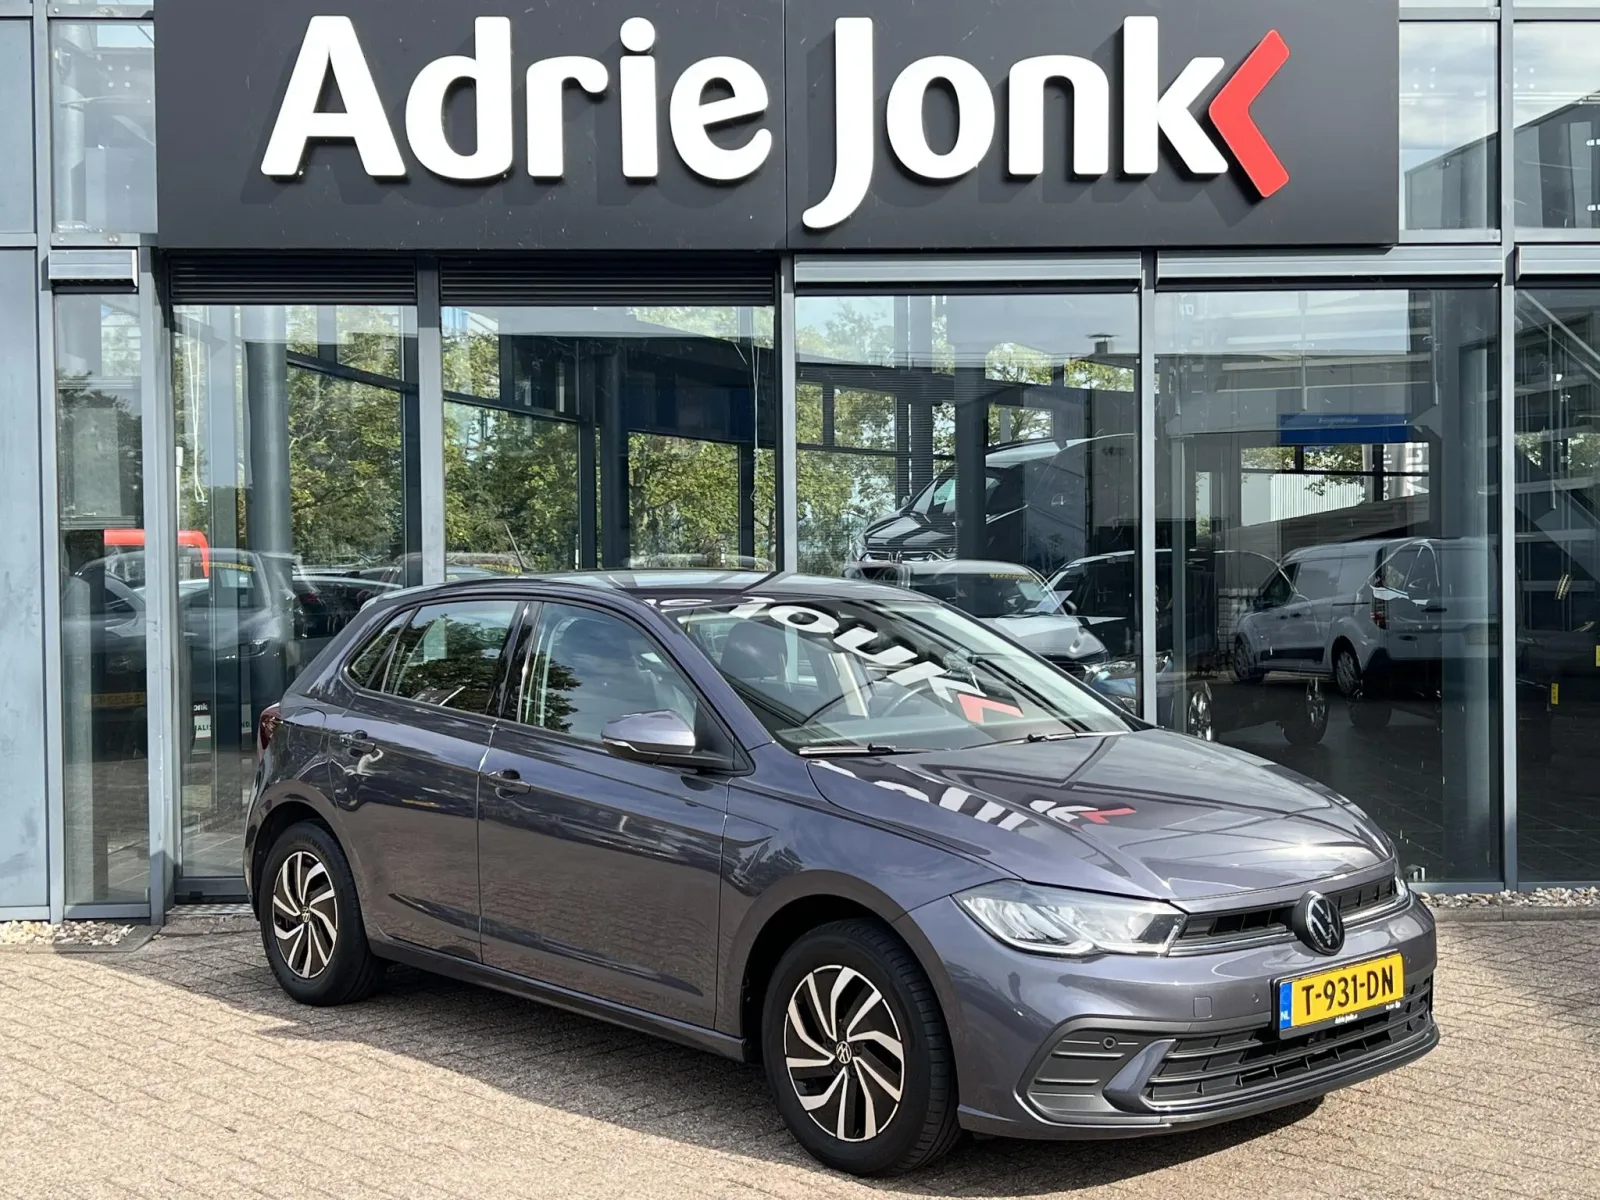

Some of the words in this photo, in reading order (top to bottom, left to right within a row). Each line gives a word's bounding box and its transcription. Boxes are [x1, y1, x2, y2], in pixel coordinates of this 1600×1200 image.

[260, 15, 772, 180] Adrie
[802, 16, 1229, 229] Jonk
[1280, 1010, 1290, 1021] NL
[1302, 965, 1394, 1016] T-931-DN
